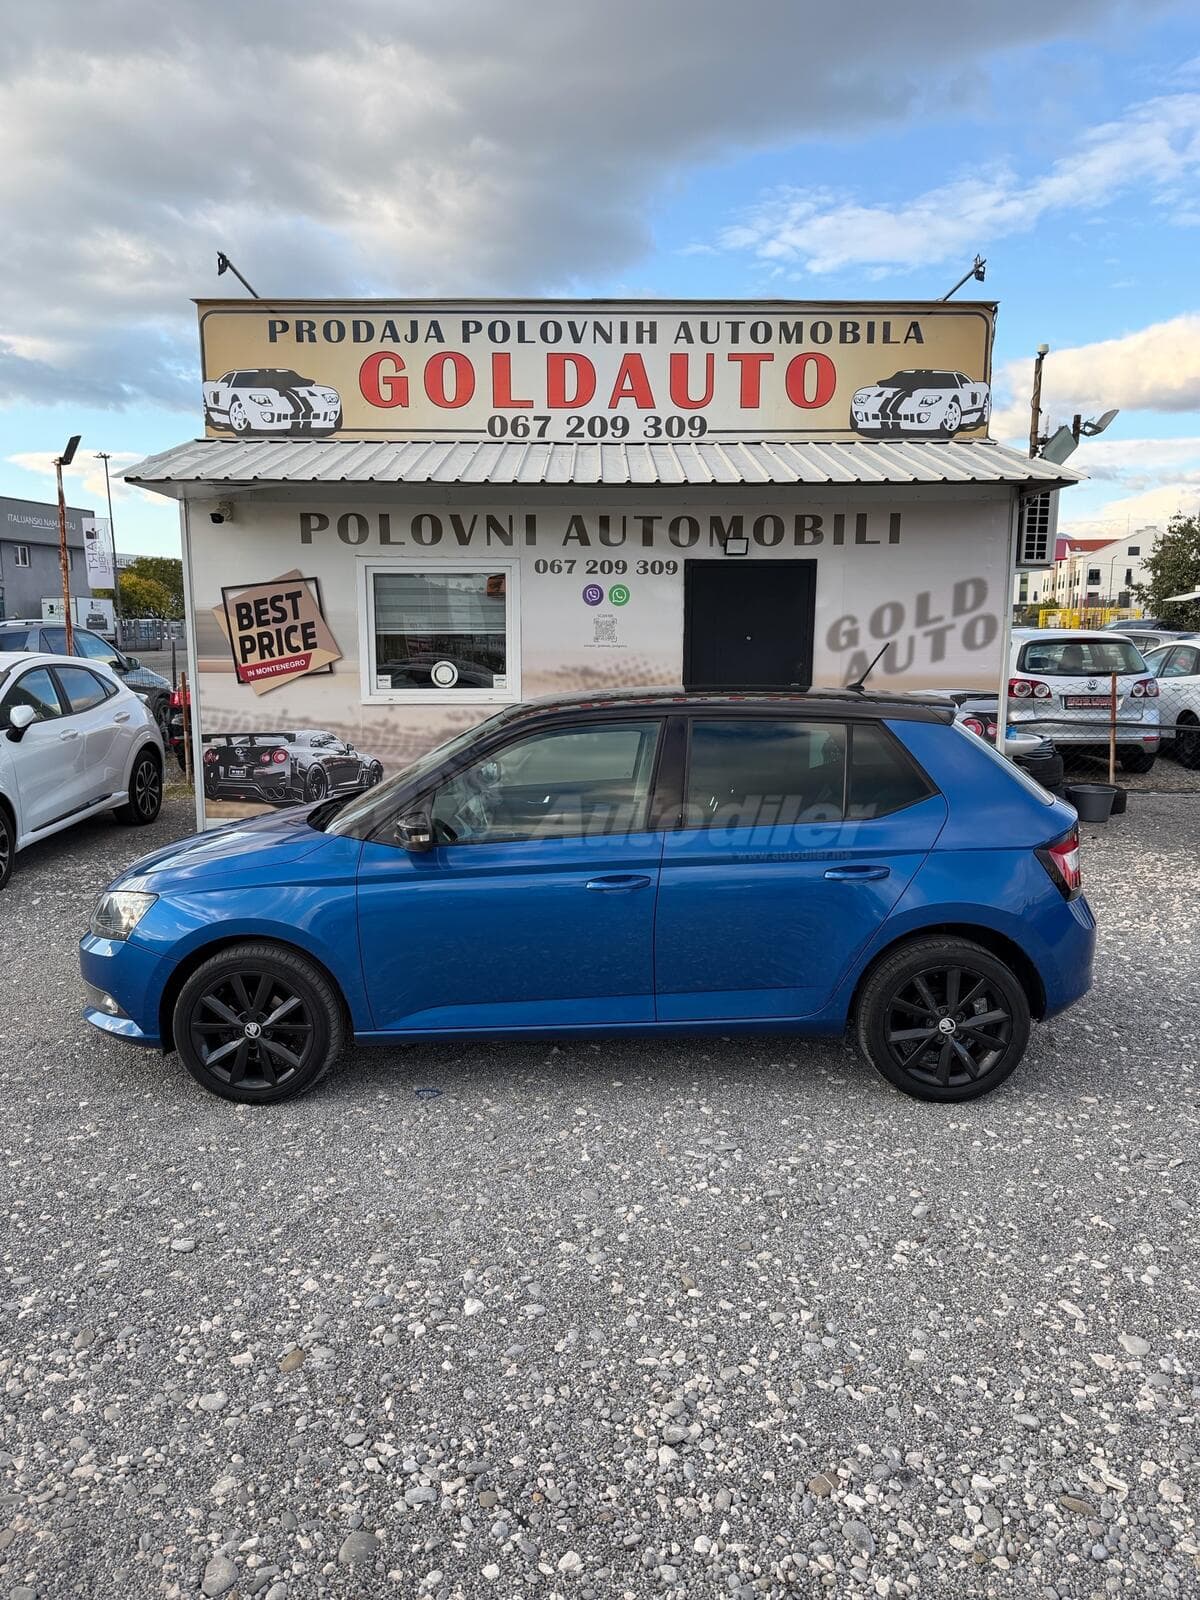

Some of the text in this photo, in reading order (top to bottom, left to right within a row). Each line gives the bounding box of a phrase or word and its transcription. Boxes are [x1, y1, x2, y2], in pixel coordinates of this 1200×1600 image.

[268, 319, 924, 345] PRODAJA POLOVNIH AUTOMOBILA
[358, 350, 838, 410] GOLDAUTO
[486, 415, 708, 439] 067 209 309
[299, 512, 902, 548] POLOVNI AUTOMOBILI
[534, 559, 679, 575] 067 209 309
[235, 590, 303, 632] BEST
[826, 577, 989, 653] GOLD
[238, 621, 318, 664] PRICE
[840, 612, 999, 688] AUTO
[255, 659, 307, 675] MONTENEGRO
